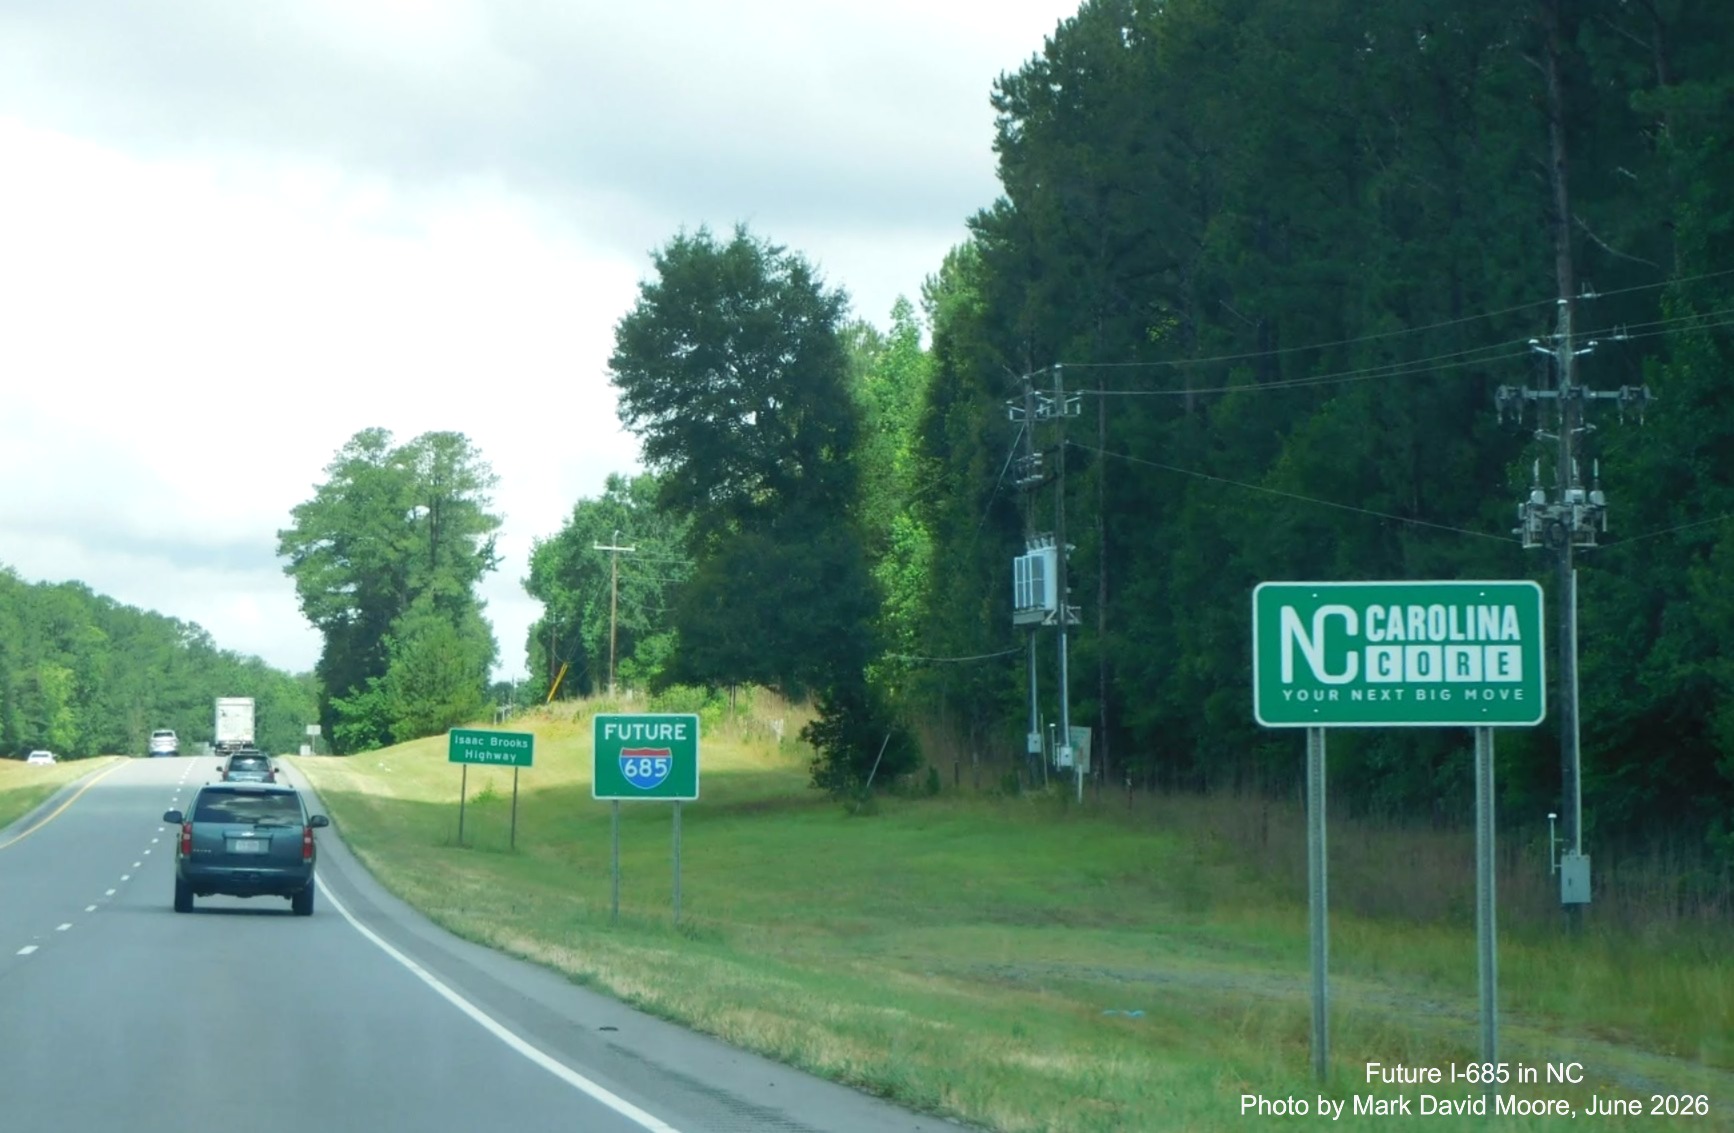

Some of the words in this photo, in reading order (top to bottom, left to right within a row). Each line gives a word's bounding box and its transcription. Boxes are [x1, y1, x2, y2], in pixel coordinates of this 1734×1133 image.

[1281, 605, 1358, 684] NC
[1365, 604, 1520, 642] CAROLINA
[1377, 652, 1509, 676] CORE
[1283, 690, 1339, 701] YOUR
[1352, 690, 1404, 700] NEXT
[1416, 690, 1452, 700] BIG
[1464, 689, 1524, 700] MOVE
[605, 724, 686, 740] FUTURE
[454, 735, 484, 746] Isaac
[490, 737, 528, 748] Brooks
[465, 750, 517, 762] Highway
[624, 758, 667, 777] 685
